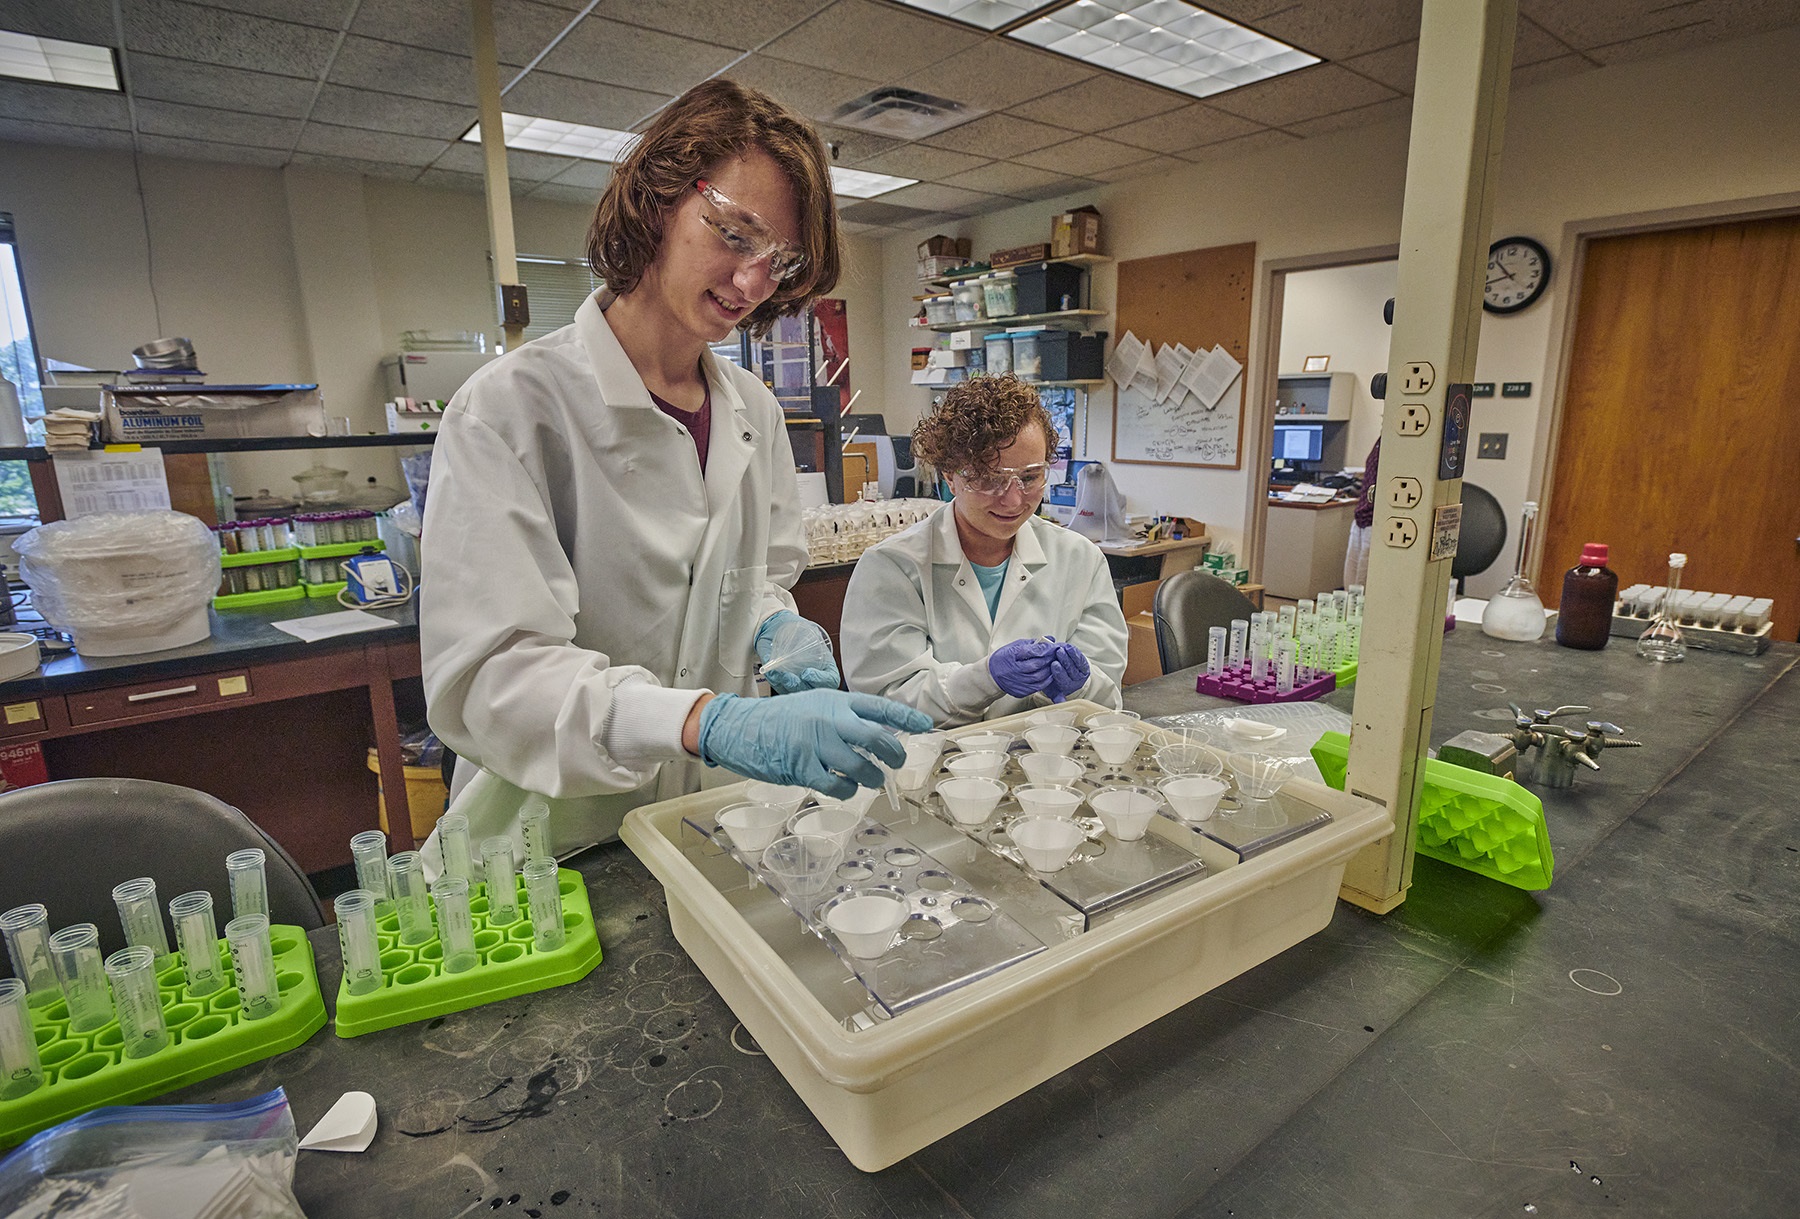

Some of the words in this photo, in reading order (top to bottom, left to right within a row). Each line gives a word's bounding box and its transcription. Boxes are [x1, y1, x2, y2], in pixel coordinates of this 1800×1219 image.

[1507, 247, 1517, 256] 12
[1530, 257, 1537, 266] 2
[1531, 270, 1539, 278] 3
[1485, 285, 1492, 293] 8
[1517, 292, 1524, 300] 5
[123, 417, 179, 427] ALUMINUM
[182, 416, 203, 426] FOIL
[0, 747, 24, 760] 946
[25, 743, 40, 755] ml
